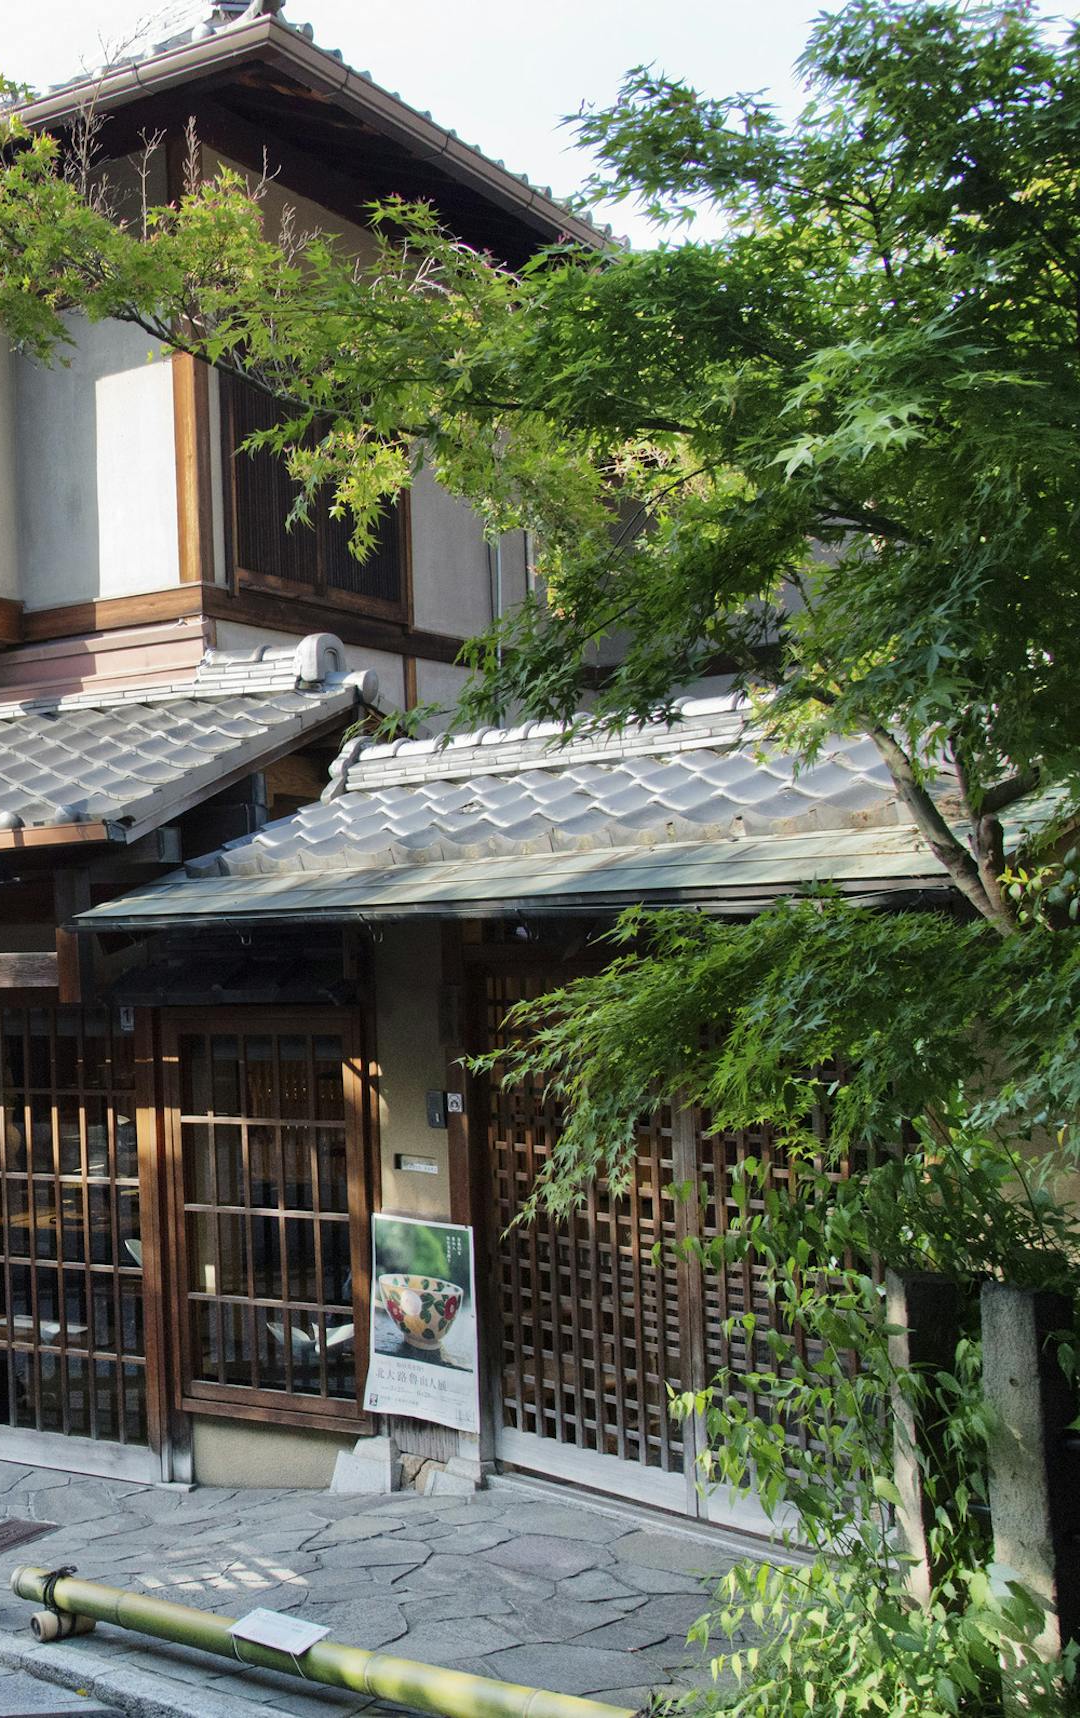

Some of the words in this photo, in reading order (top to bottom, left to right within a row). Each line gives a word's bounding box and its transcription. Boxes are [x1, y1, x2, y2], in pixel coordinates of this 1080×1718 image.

[376, 1367, 448, 1392] 北大路魯山人展
